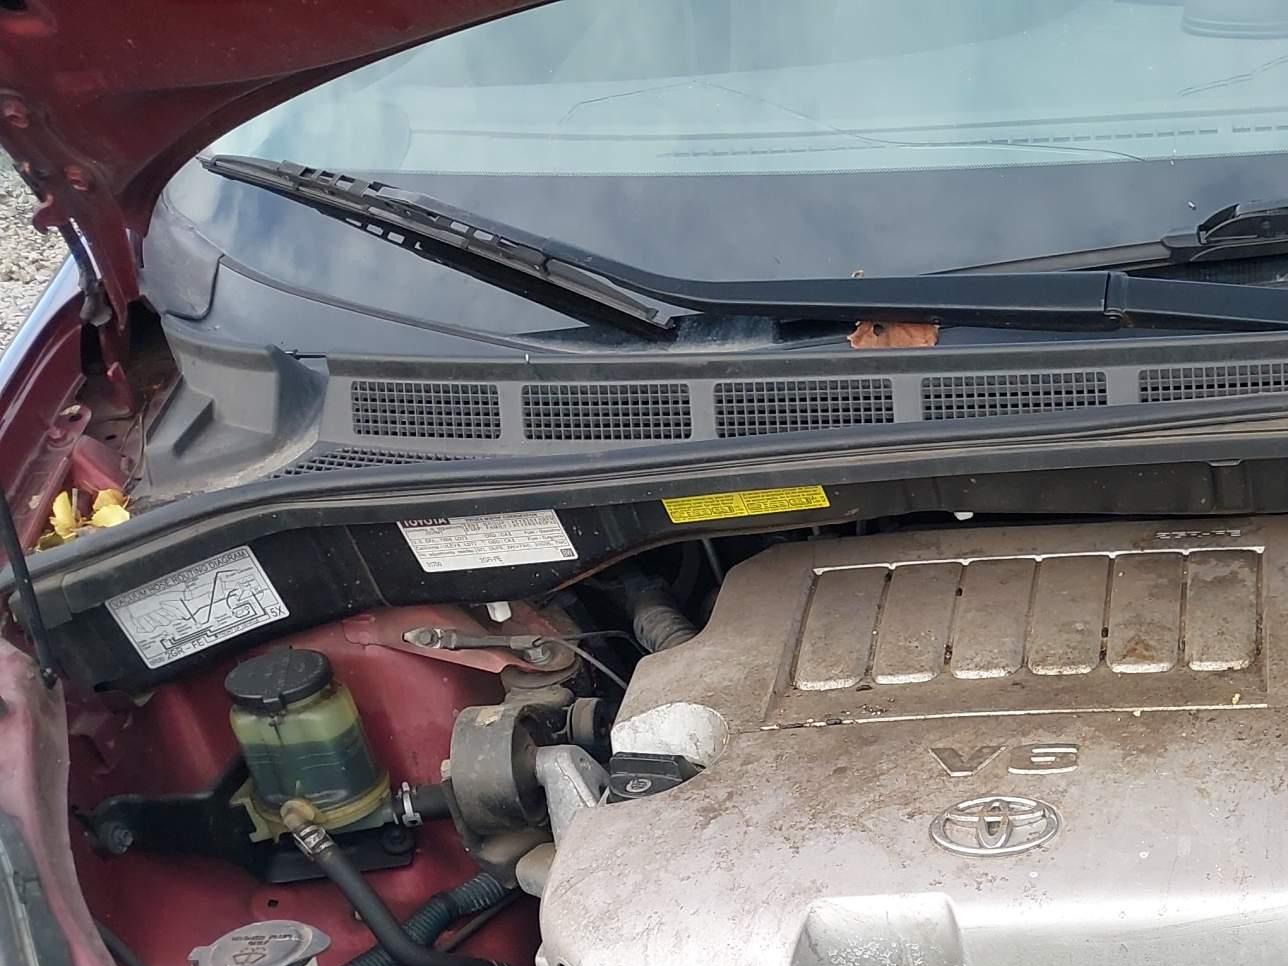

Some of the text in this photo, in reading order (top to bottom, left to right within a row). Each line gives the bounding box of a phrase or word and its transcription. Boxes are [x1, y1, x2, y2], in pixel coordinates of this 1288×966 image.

[206, 549, 247, 570] DIAGRAM
[270, 605, 284, 618] 5X
[928, 743, 1080, 776] V6
